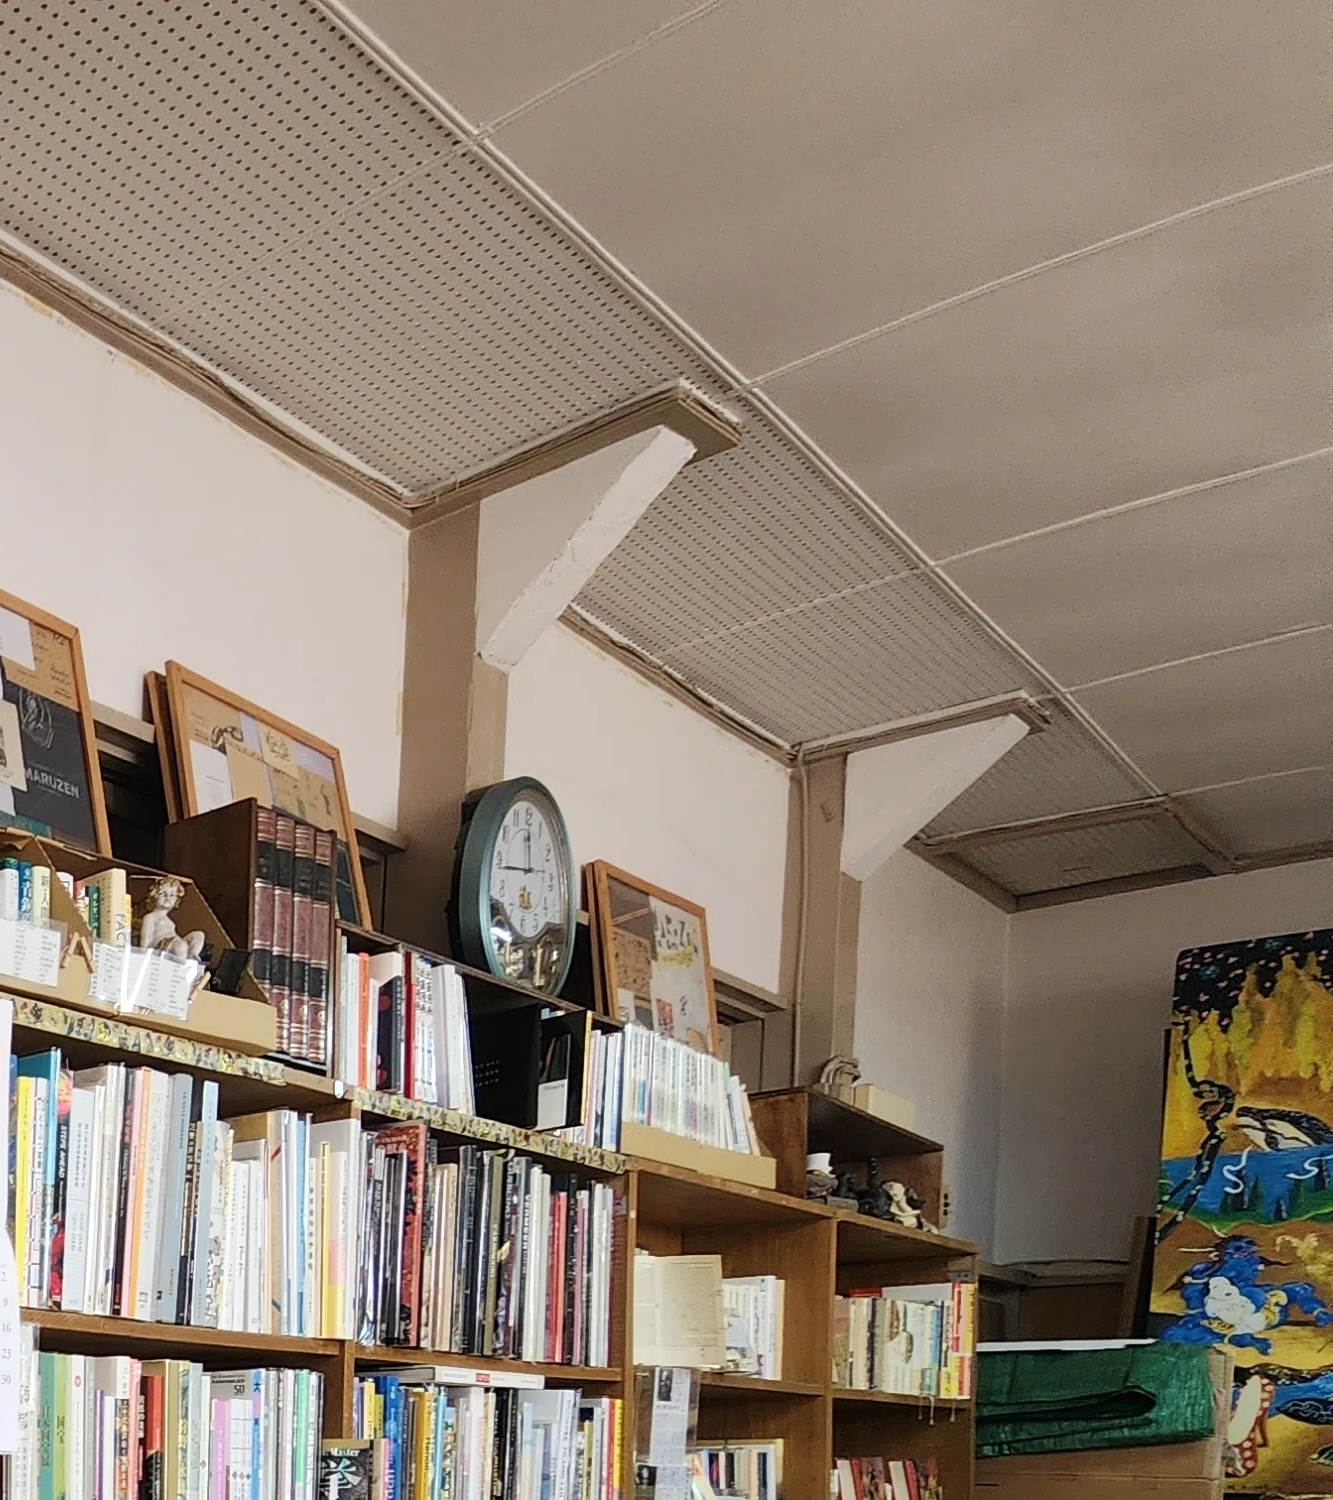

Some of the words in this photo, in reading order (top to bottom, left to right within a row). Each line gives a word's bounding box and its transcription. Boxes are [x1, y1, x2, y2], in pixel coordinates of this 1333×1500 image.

[24, 767, 81, 799] MARUZEN
[1, 1322, 12, 1333] 16
[0, 1374, 12, 1386] 30
